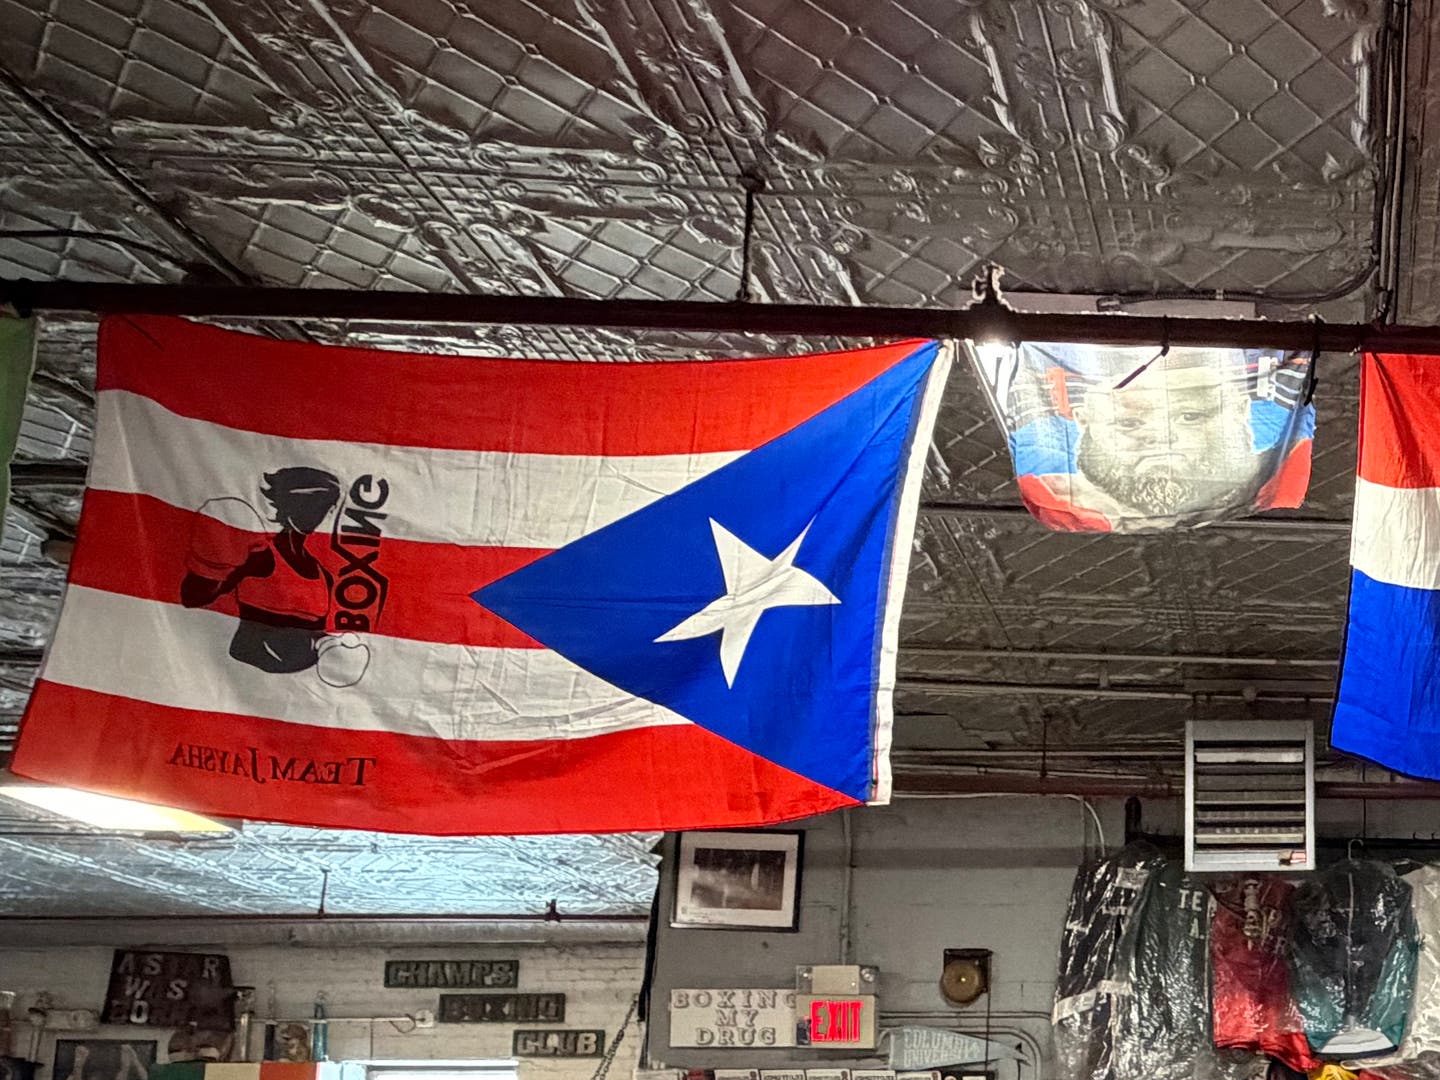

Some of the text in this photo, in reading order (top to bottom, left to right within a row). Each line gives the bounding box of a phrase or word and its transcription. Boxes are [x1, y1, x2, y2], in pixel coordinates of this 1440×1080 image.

[388, 961, 512, 986] CHAMPS
[123, 975, 188, 1000] WS
[715, 1009, 760, 1028] MY
[810, 1000, 865, 1043] EXIT
[695, 1027, 776, 1046] DRUG
